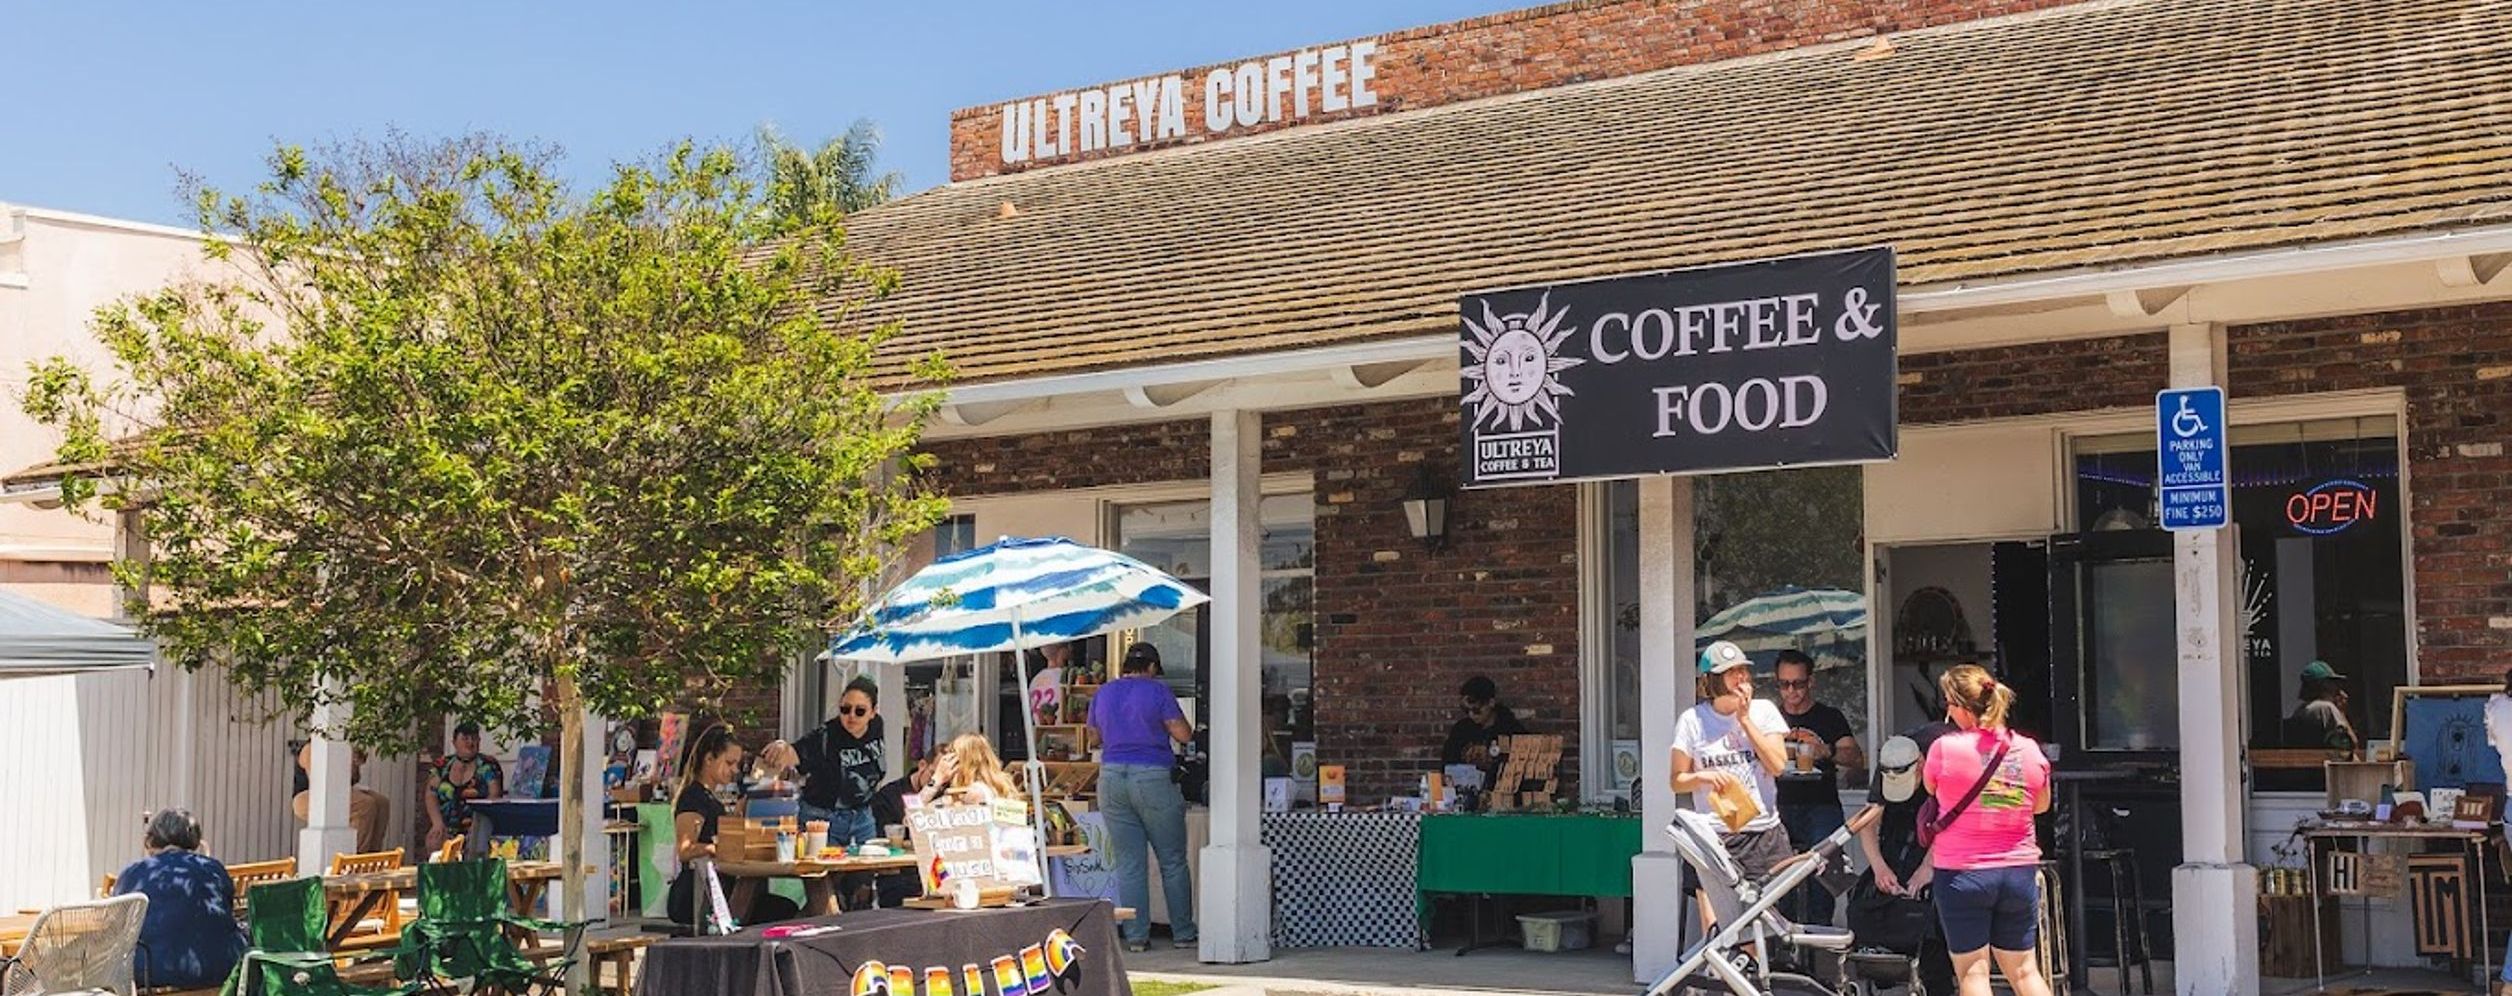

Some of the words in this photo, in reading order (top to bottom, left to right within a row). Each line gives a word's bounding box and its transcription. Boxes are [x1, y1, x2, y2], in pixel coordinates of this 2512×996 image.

[1001, 75, 1186, 164] ULTREYA
[1204, 42, 1378, 131] COFFEE
[1590, 292, 1821, 364] COFFEE
[1834, 286, 1883, 341] &
[1652, 374, 1828, 438] FOOD
[1481, 438, 1553, 459] ULTREYA
[2169, 438, 2213, 453] PARKING
[1480, 459, 1519, 472] COFFEE
[1534, 457, 1554, 469] TEA
[2179, 450, 2204, 463] ONLY
[2183, 461, 2201, 472] VAN
[2165, 470, 2221, 485] ACCESSIBLE
[2170, 490, 2217, 504] MINIMUM
[2165, 506, 2189, 520] FINE
[2192, 504, 2223, 519] $250
[2286, 489, 2377, 524] OPEN
[1701, 749, 1759, 769] BASKETB
